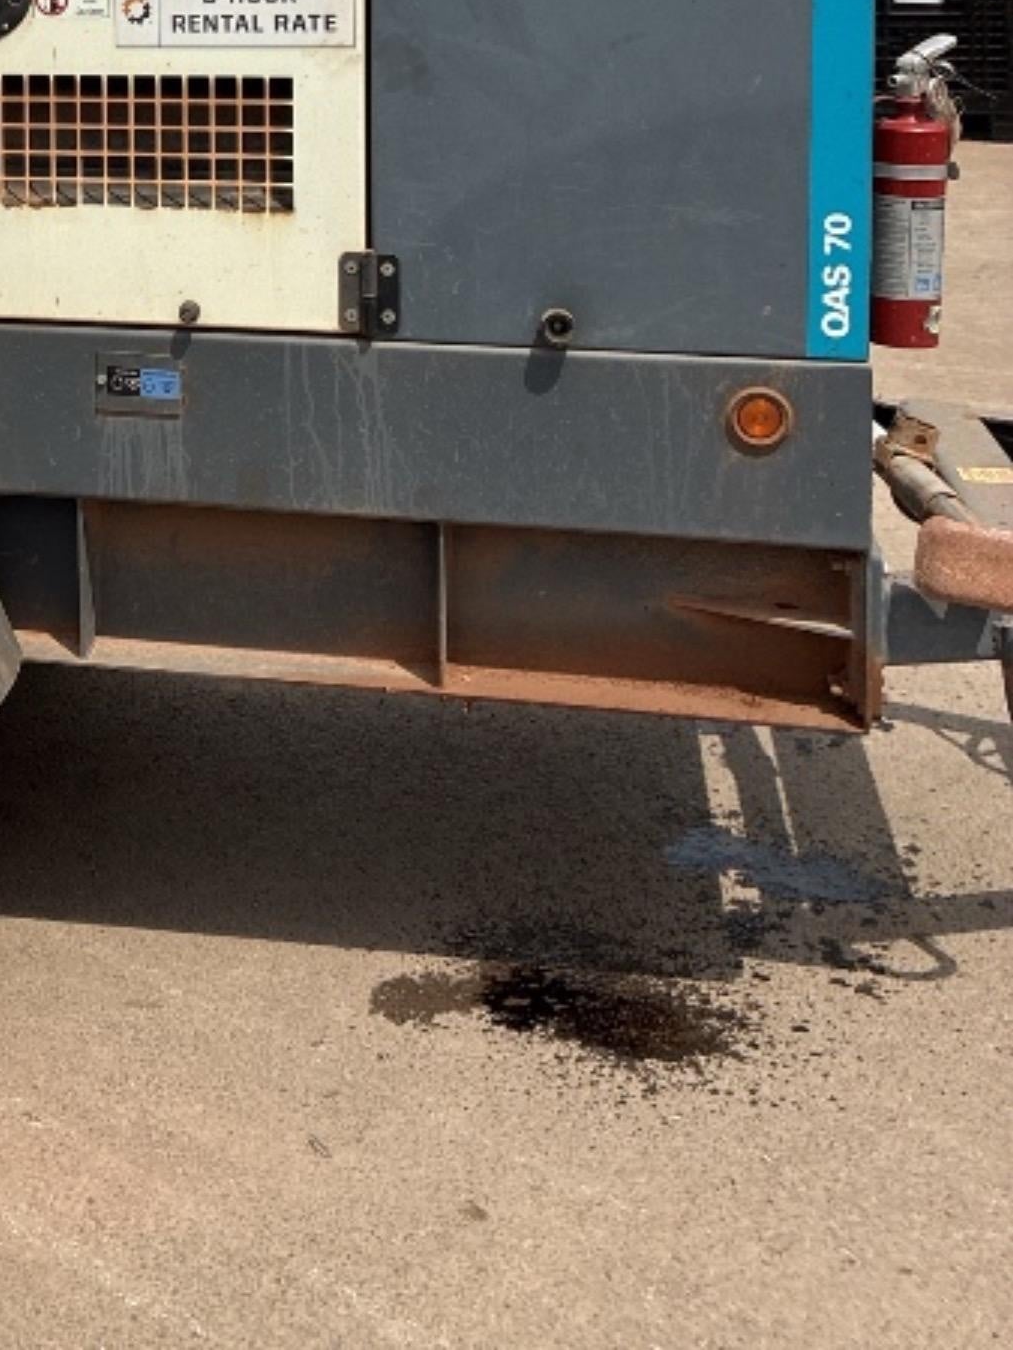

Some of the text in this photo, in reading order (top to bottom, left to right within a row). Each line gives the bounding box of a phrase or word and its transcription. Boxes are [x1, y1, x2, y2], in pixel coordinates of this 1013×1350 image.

[171, 13, 337, 34] RENTAL RATE
[820, 212, 853, 338] QAS 70
